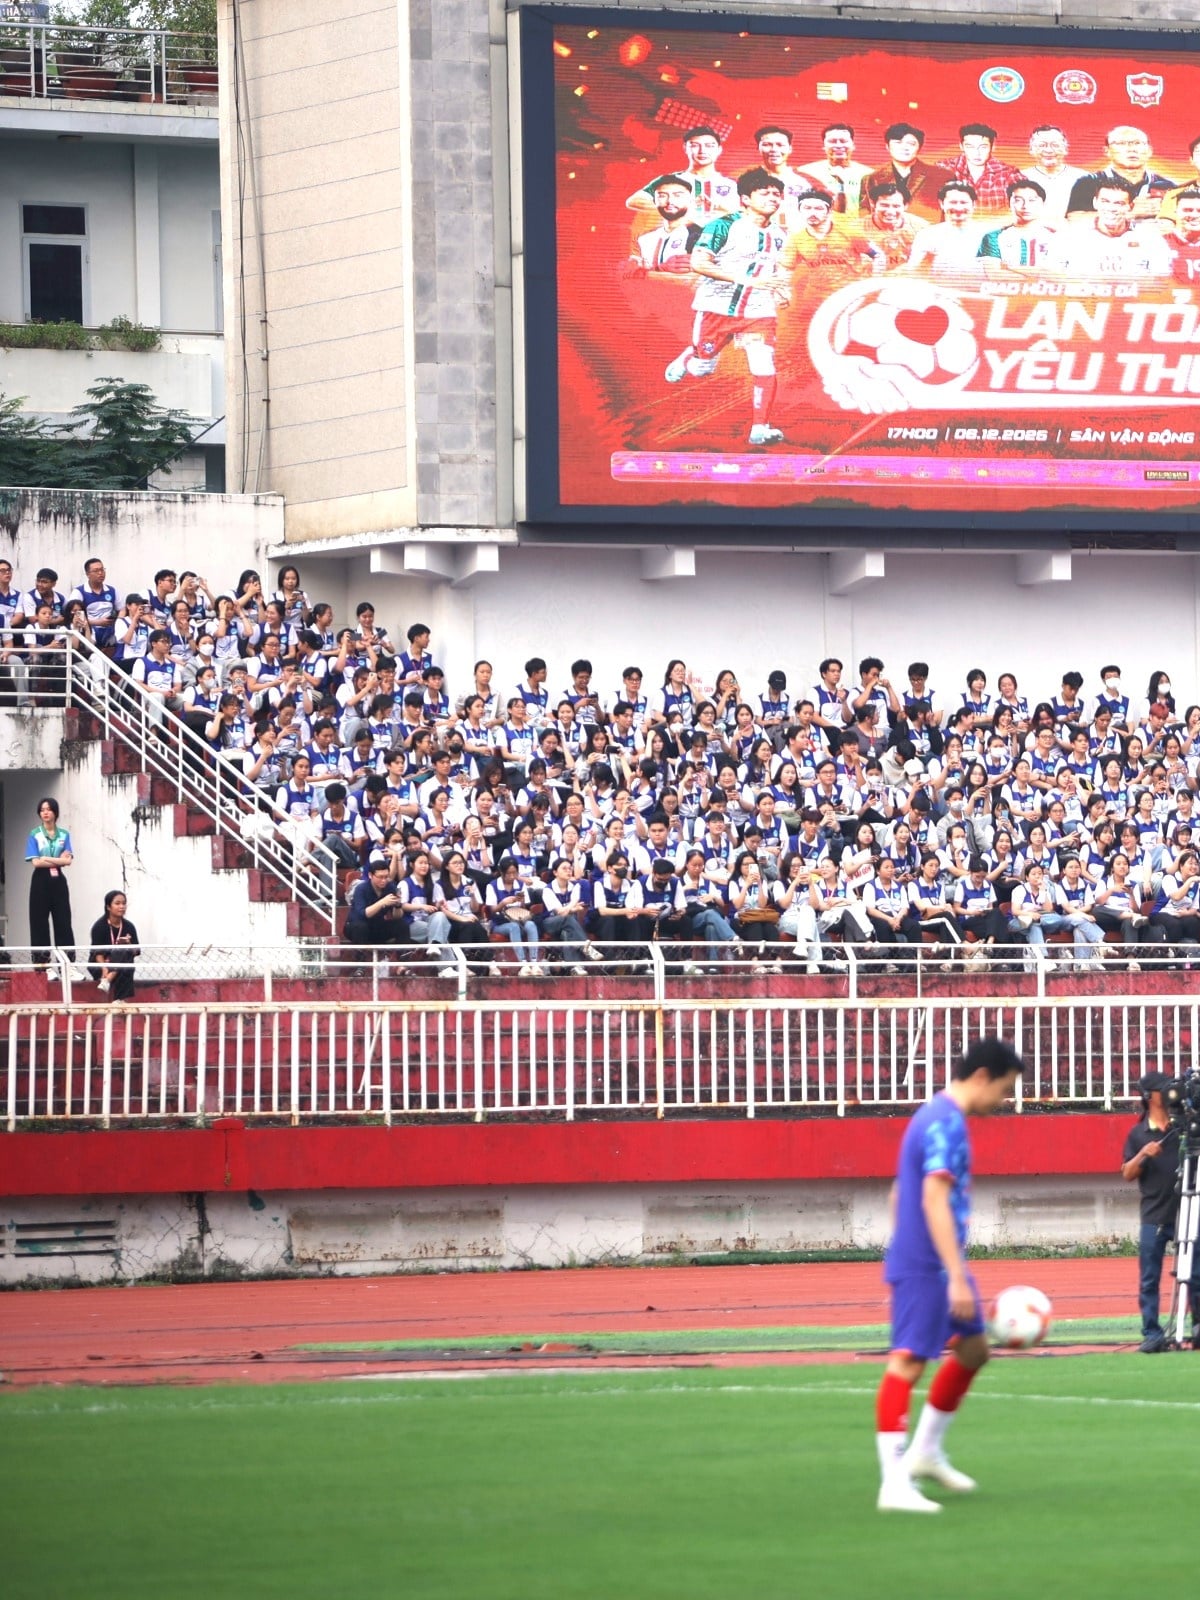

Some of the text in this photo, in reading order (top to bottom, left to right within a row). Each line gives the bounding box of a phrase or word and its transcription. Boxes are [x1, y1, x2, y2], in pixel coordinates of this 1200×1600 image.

[985, 298, 1112, 341] LAN
[983, 340, 1105, 391] YÊU
[1069, 428, 1105, 443] SÂN
[1110, 428, 1144, 446] VẬN
[1147, 428, 1195, 446] ĐỘNG
